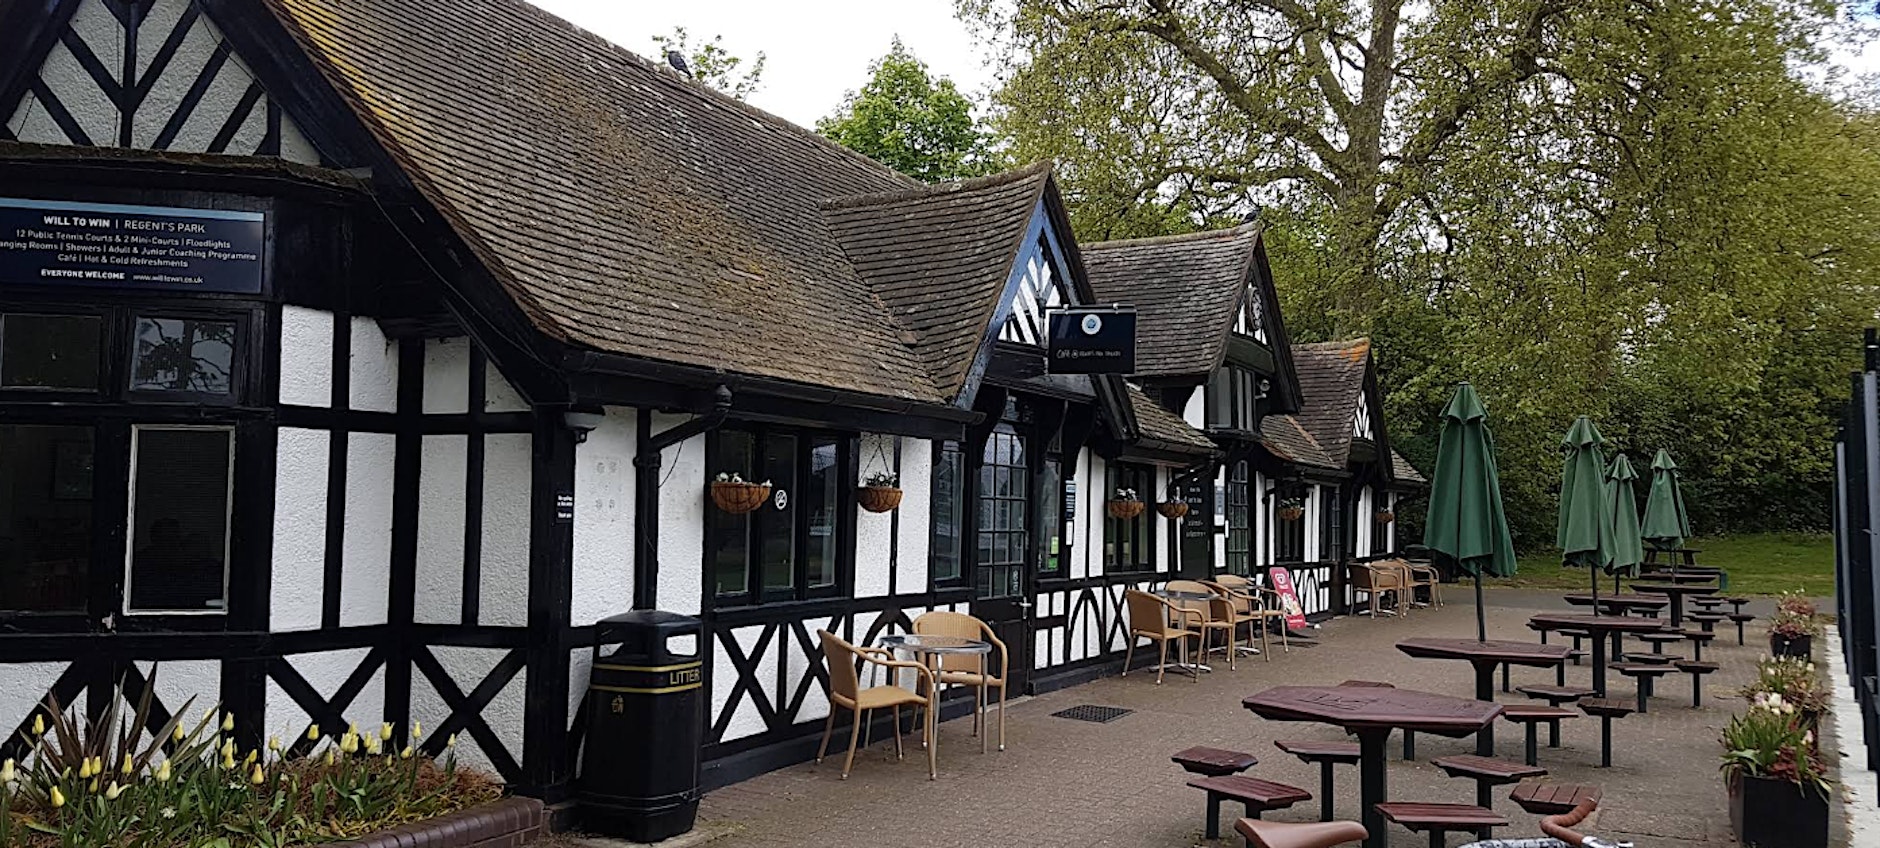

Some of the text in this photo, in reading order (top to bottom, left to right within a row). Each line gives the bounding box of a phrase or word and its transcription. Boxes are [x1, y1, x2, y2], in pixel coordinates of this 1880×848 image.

[44, 216, 70, 225] WILL
[72, 217, 86, 226] TO
[89, 219, 110, 227] WIN
[125, 220, 175, 232] REGENT'S
[178, 223, 205, 233] PARK
[17, 229, 25, 237] 12
[28, 230, 53, 239] Public
[56, 232, 83, 240] Tennis
[85, 233, 112, 242] Courts
[124, 235, 129, 243] 2
[131, 236, 179, 245] Mini-Courts
[186, 239, 231, 249] Floodlights
[29, 241, 58, 249] Rooms
[66, 243, 101, 252] Showers
[109, 245, 130, 253] Adult
[141, 247, 167, 255] Junior
[169, 248, 206, 259] Coaching
[208, 250, 257, 260] Programme
[85, 255, 99, 263] Hot
[110, 256, 129, 264] Cold
[130, 257, 188, 267] Refreshments
[41, 269, 83, 278] EVERYONE
[85, 271, 125, 279] WELCOME
[669, 668, 700, 685] LITTER
